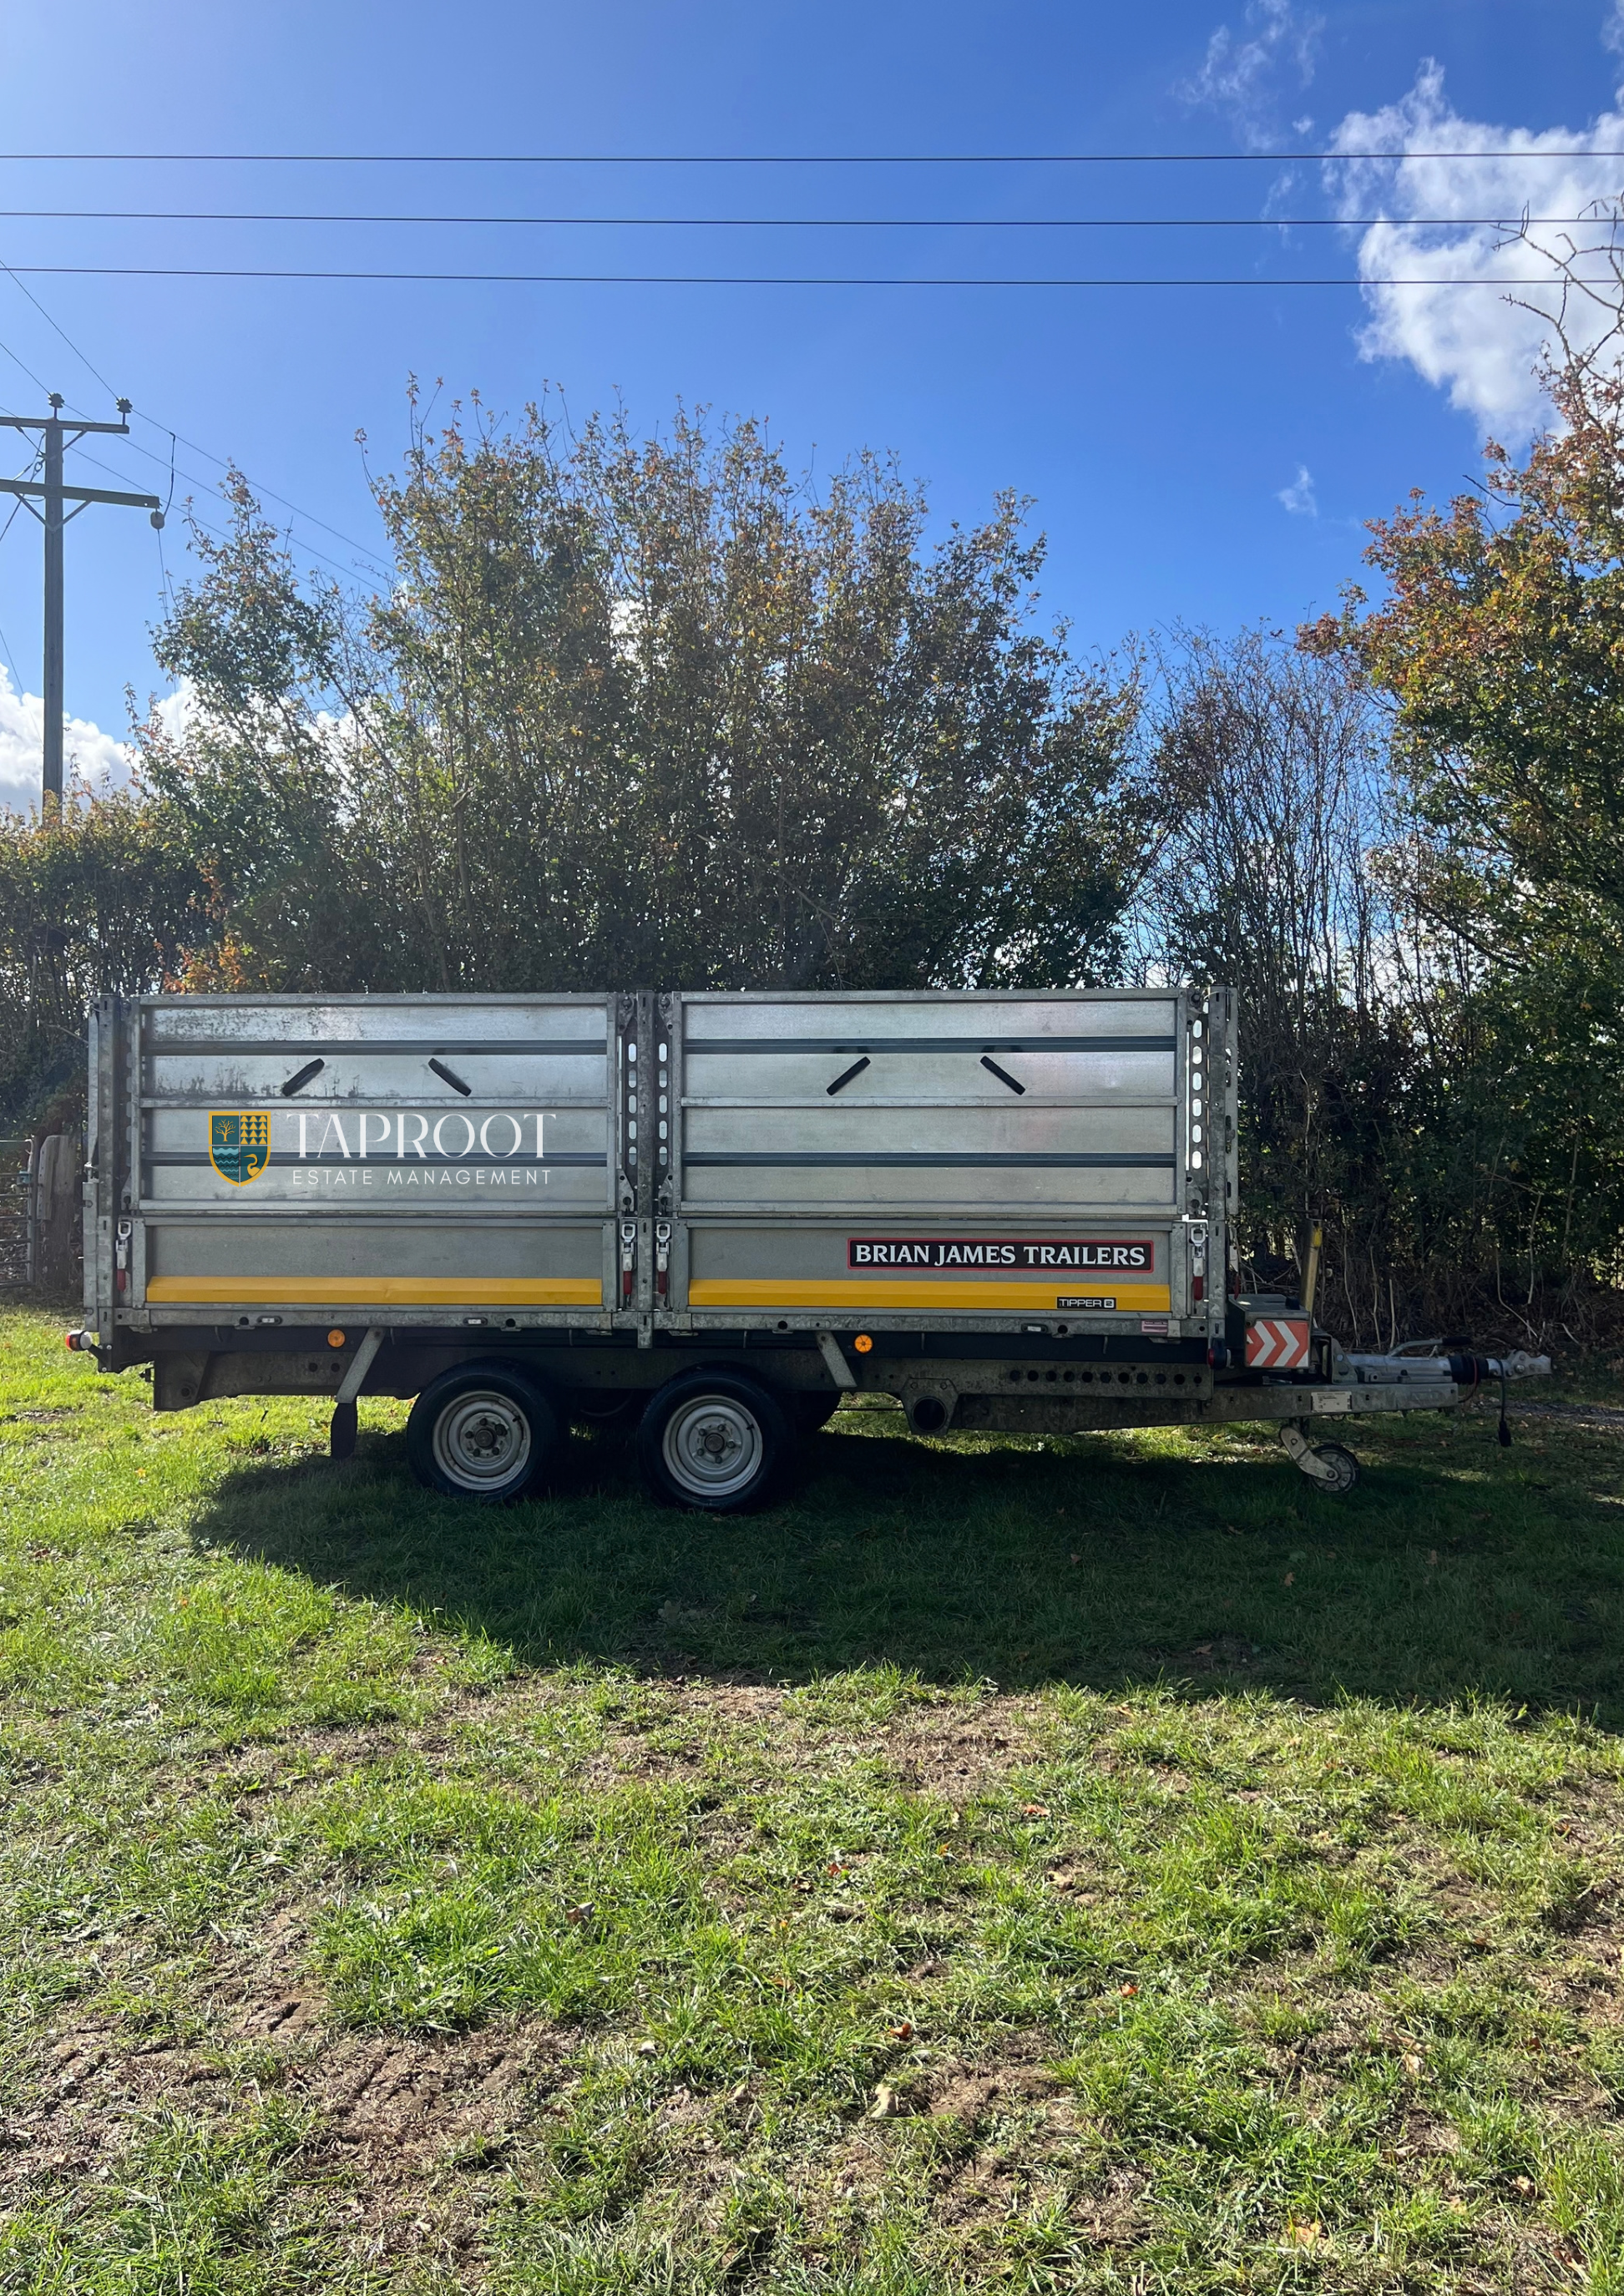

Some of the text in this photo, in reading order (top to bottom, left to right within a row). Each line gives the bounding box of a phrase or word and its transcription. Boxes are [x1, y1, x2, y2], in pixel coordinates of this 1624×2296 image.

[855, 1244, 1146, 1267] BRIAN JAMES TRAILERS
[1059, 1298, 1102, 1307] TIPPER
